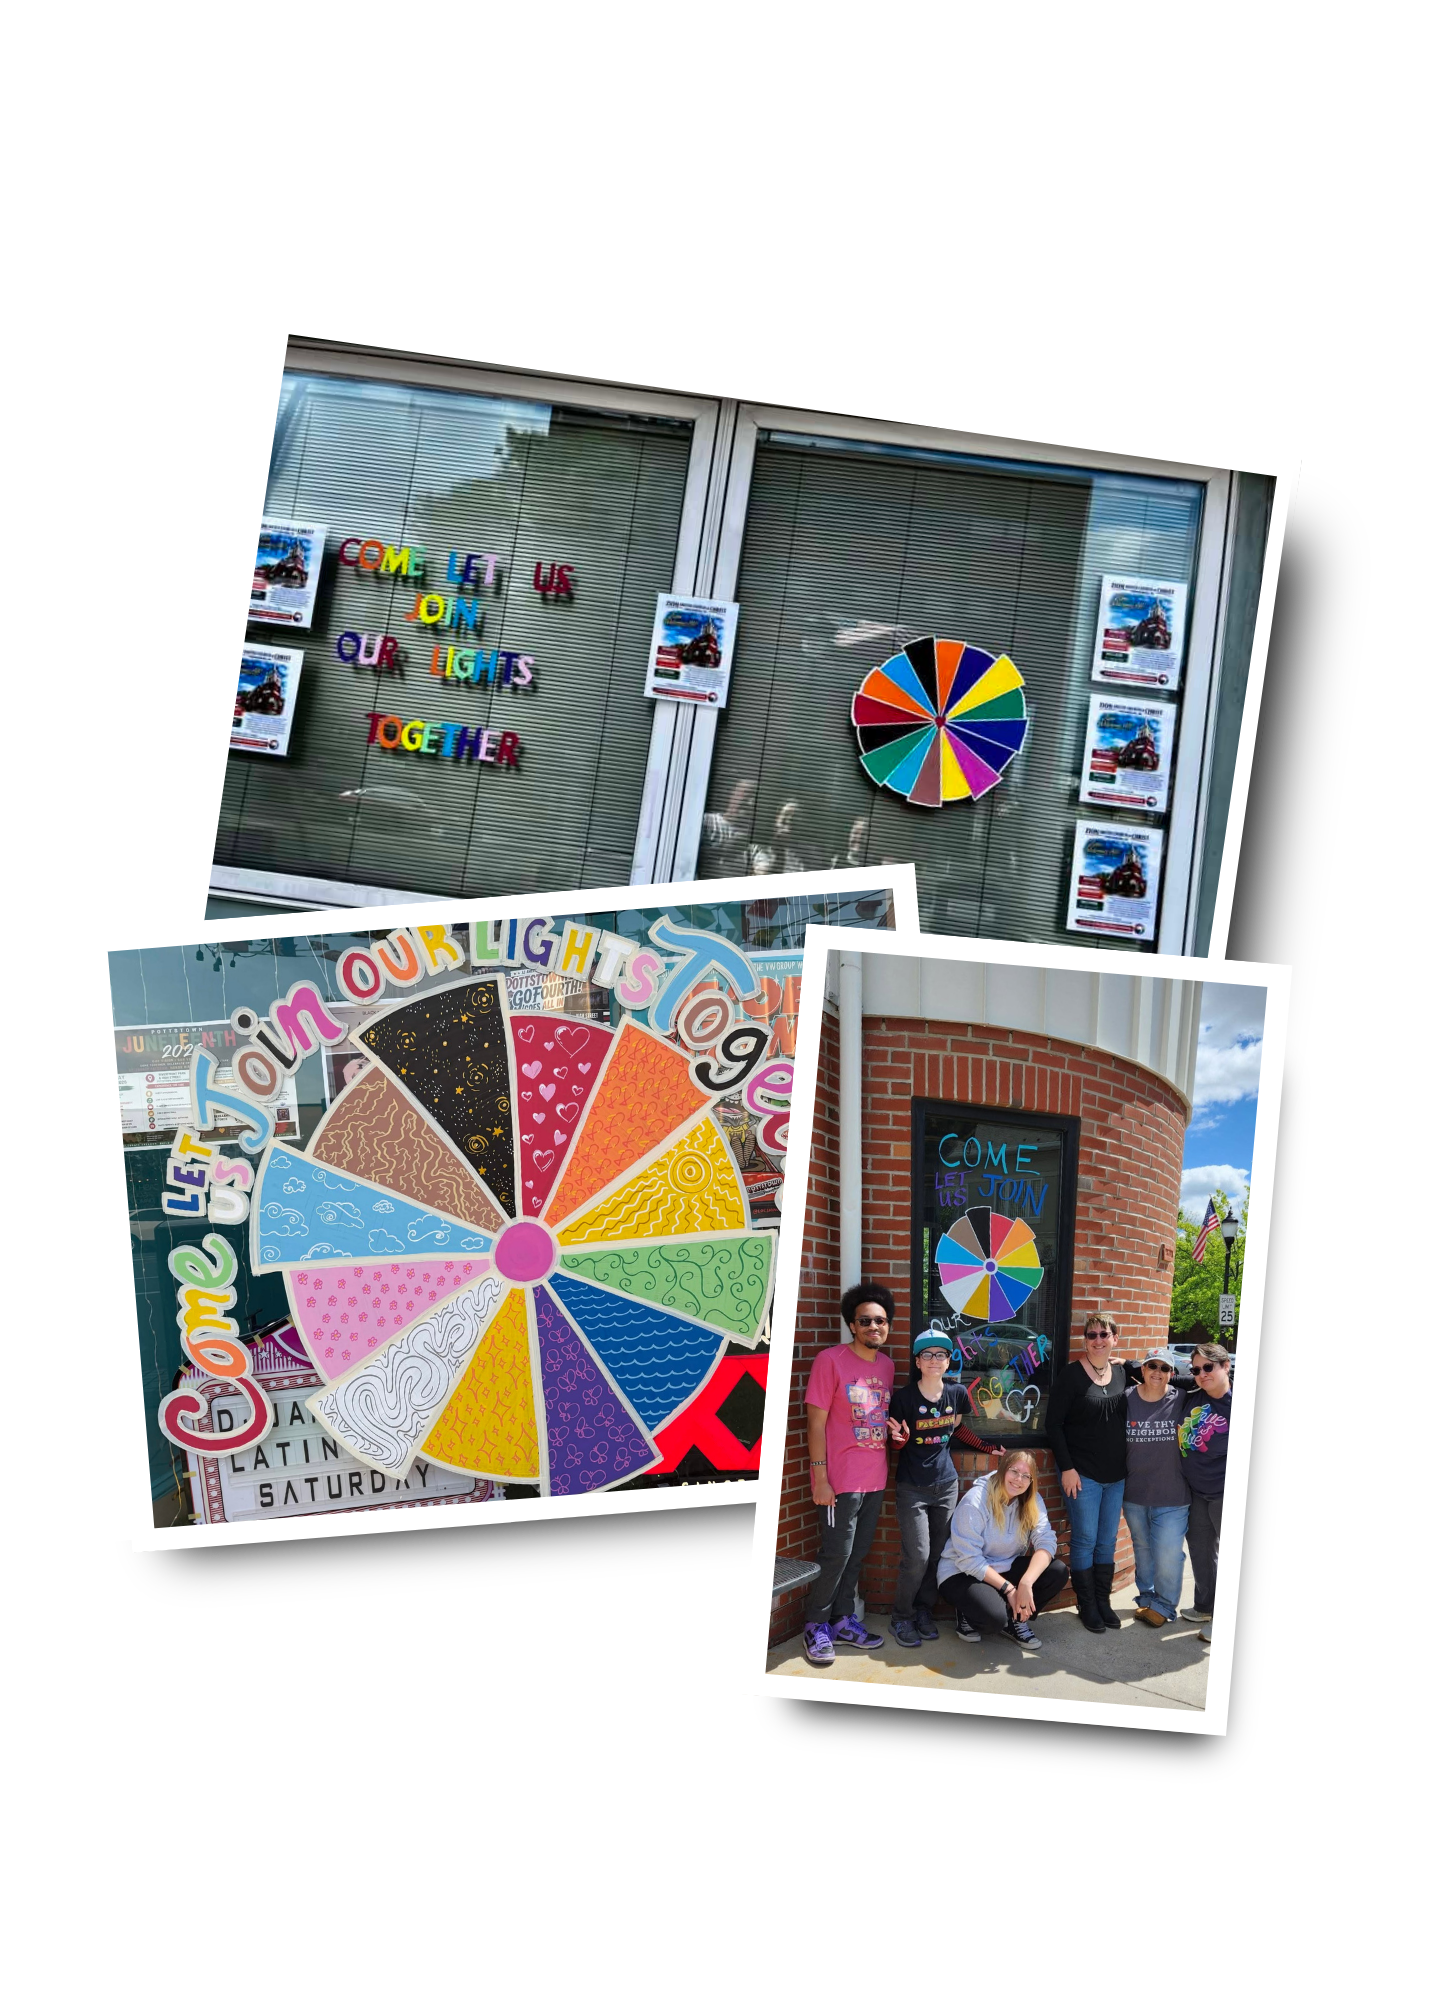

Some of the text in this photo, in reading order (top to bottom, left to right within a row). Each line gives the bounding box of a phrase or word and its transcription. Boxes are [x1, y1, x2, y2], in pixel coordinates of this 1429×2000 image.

[339, 538, 575, 594] COME LET US
[403, 593, 479, 630] JOIN
[337, 631, 535, 685] OUR LIGHTS
[366, 712, 520, 767] TOGETHER
[342, 925, 460, 999] OUR
[475, 918, 660, 1001] LIGHTS
[776, 961, 796, 970] GROUP
[150, 1027, 204, 1035] POTTSTOWN
[162, 1043, 204, 1059] 202
[197, 988, 344, 1148] Join
[167, 1133, 213, 1212] LET
[938, 1133, 1040, 1175] COME
[211, 1159, 250, 1218] US
[935, 1170, 1049, 1216] LET JOIN
[939, 1187, 967, 1207] US
[1220, 1311, 1233, 1322] 25
[164, 1238, 268, 1452] Come
[967, 1334, 1050, 1417] TOGETHER
[1126, 1428, 1177, 1436] NEIGHBOR
[1154, 1420, 1175, 1428] THY
[231, 1437, 338, 1473] LATIN
